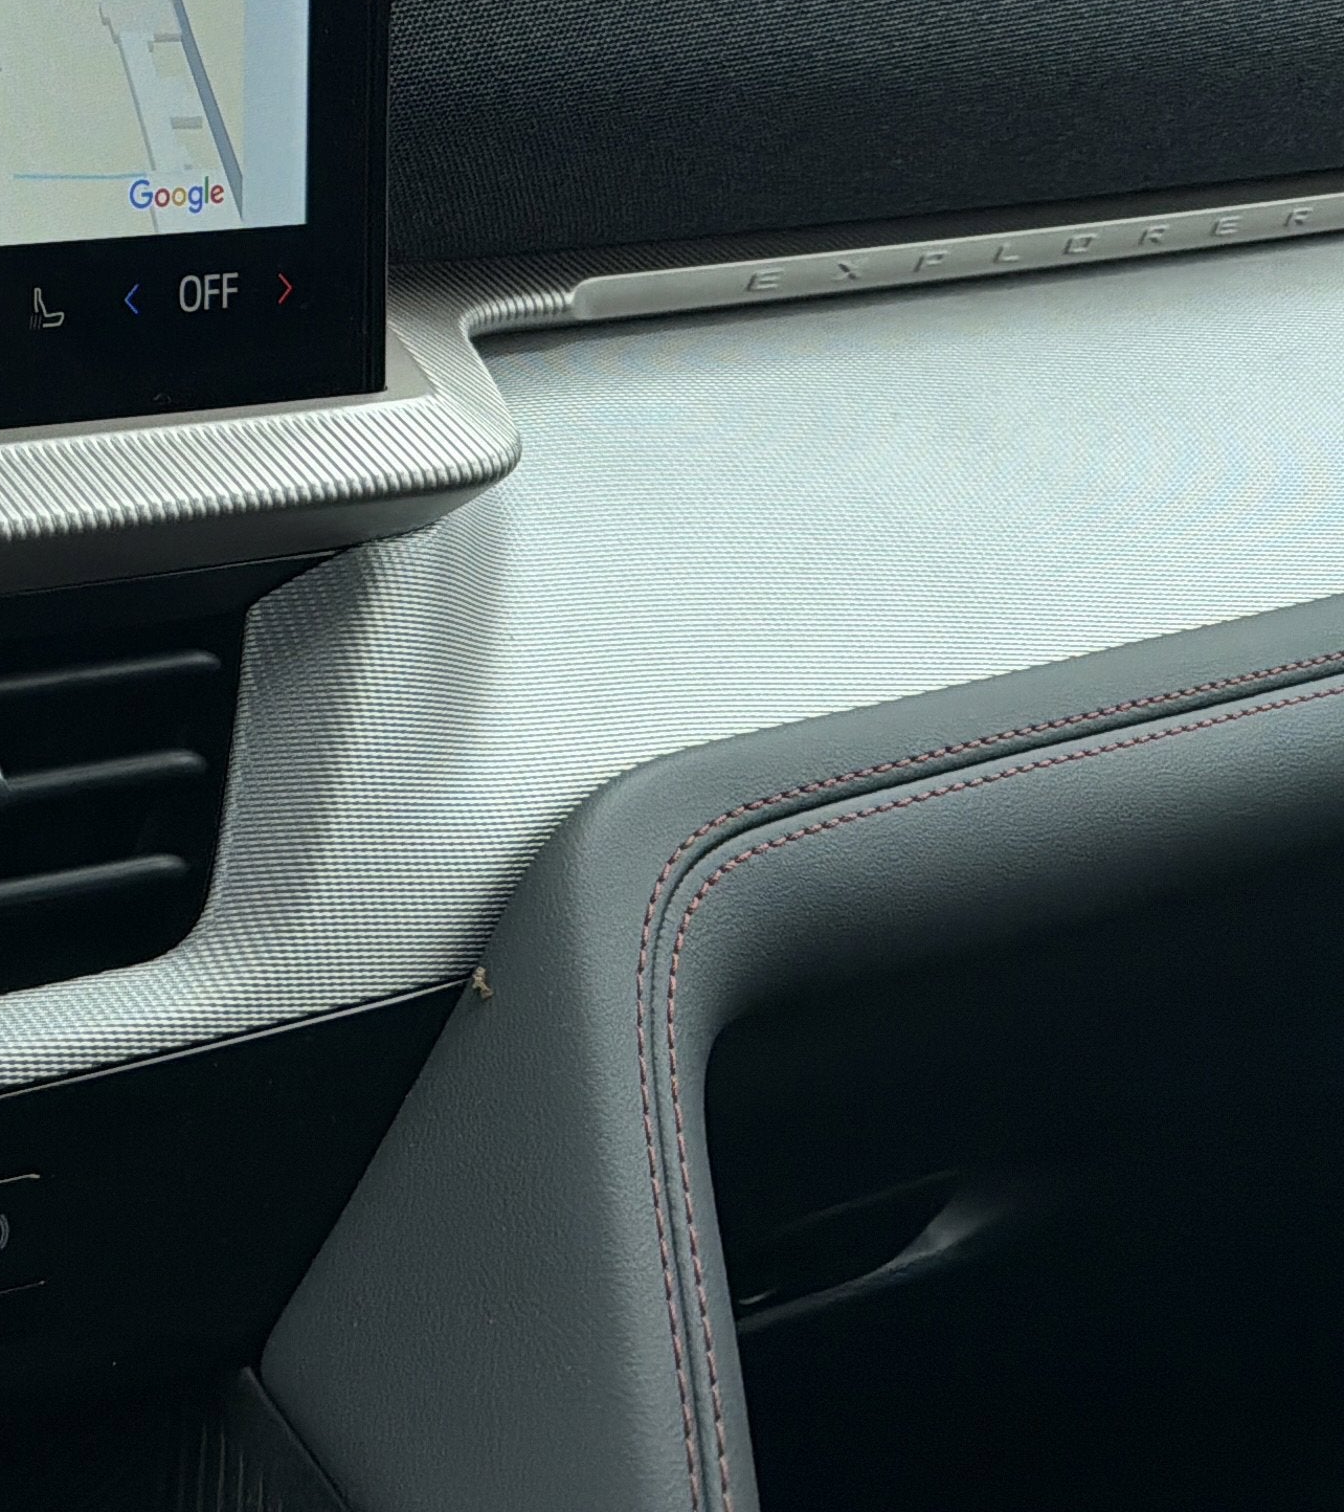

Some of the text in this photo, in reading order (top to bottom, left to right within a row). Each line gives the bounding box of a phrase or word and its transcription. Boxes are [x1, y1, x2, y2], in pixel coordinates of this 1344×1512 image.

[129, 176, 225, 214] Google
[746, 206, 1314, 291] EXPLORER
[178, 272, 240, 312] OFF
